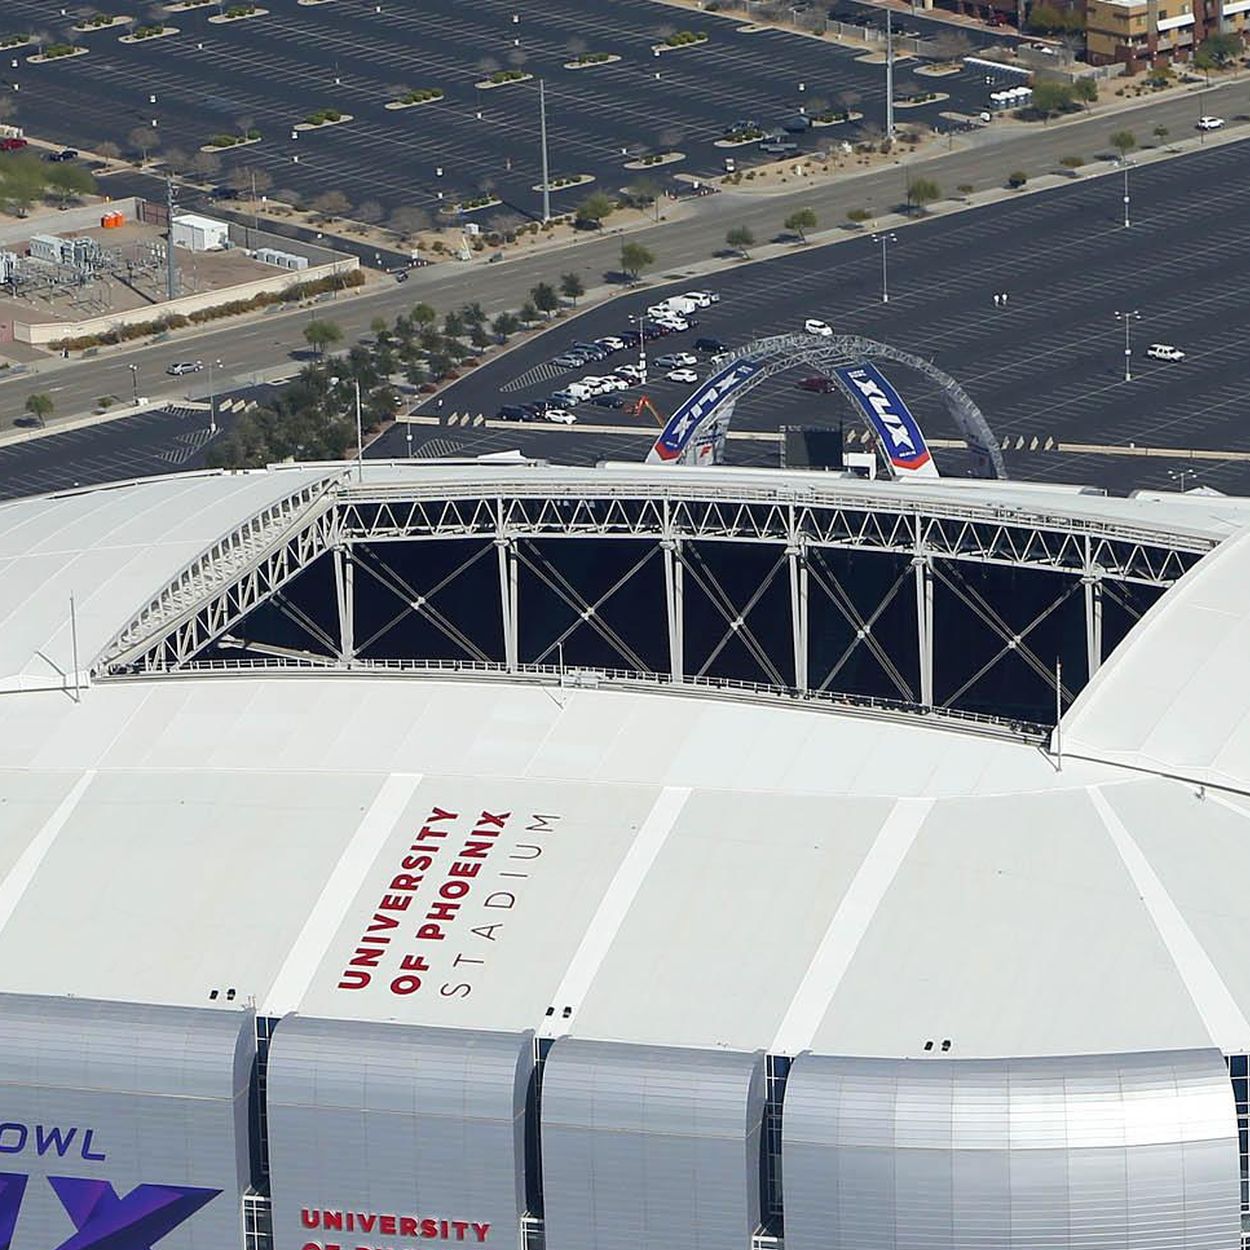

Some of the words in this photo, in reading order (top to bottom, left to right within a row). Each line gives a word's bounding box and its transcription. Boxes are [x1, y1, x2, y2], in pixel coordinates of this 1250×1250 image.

[672, 370, 738, 443] XLIX
[854, 379, 916, 454] XLIX
[337, 806, 458, 990] UNIVERSITY
[389, 955, 430, 995] OF
[415, 810, 512, 941] PHOENIX
[439, 813, 560, 998] STADIUM
[301, 1208, 491, 1243] UNIVERSITY
